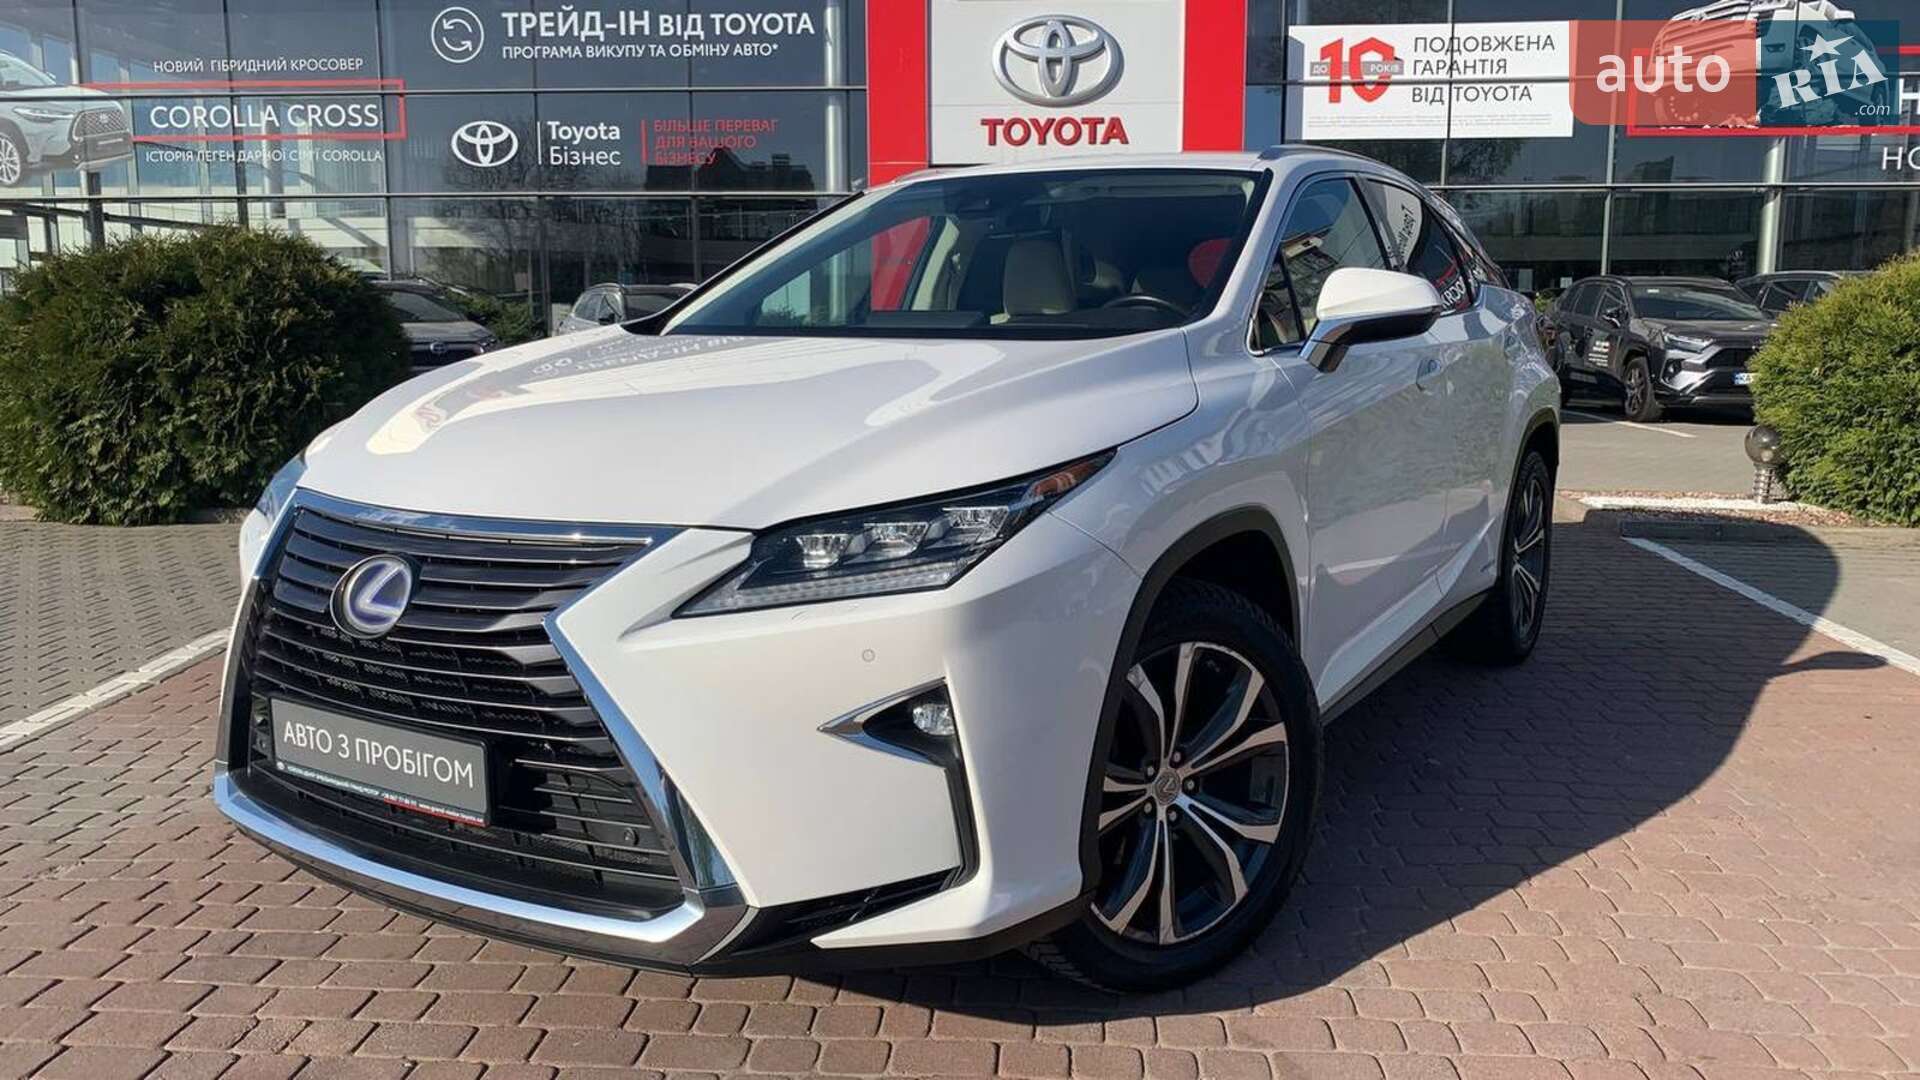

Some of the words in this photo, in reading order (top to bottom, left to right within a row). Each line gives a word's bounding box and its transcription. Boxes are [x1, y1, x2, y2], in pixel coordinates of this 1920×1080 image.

[501, 6, 650, 41] ТРЕЙД-ІН
[659, 15, 704, 41] ВІД
[710, 12, 815, 36] TOYOTA
[503, 46, 582, 60] ПРОГРАМА
[586, 45, 644, 60] ВИКУПУ
[648, 45, 666, 58] ТА
[669, 44, 730, 58] ОБМІНУ
[1413, 35, 1556, 55] ПОДОВЖЕНА
[153, 58, 204, 74] НОВИЙ
[210, 57, 287, 73] ГІБРИДНИЙ
[290, 58, 364, 72] КРОСОВЕР
[1413, 59, 1508, 76] ГАРАНТІЯ
[1411, 86, 1446, 106] ВІД
[150, 104, 279, 129] COROLLA
[287, 104, 379, 128] CROSS
[547, 121, 620, 144] Toyota
[980, 116, 1129, 147] TOYOTA
[146, 150, 194, 163] ІСТОРІЯ
[323, 149, 383, 162] COROLLA
[549, 146, 621, 165] Бізнес
[284, 721, 332, 754] АВТО
[355, 738, 474, 788] ПРОБІГОМ
